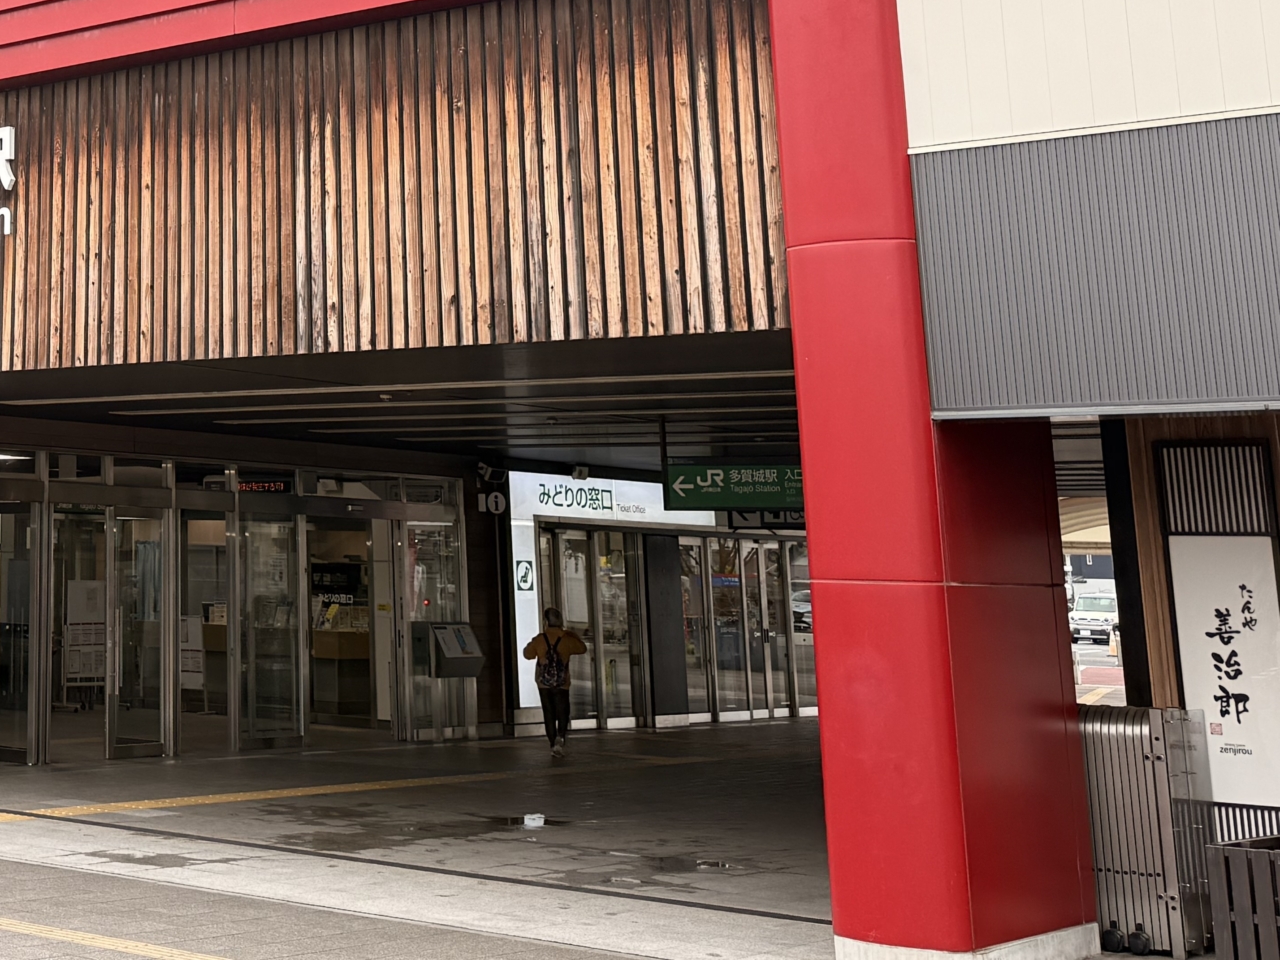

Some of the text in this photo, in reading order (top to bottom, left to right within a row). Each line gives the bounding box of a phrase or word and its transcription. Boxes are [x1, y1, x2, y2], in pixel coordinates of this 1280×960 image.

[696, 469, 725, 486] JR
[729, 469, 778, 483] 多賀城駅
[755, 483, 781, 492] Station
[538, 483, 613, 512] みどりの窓口
[1219, 746, 1253, 756] zenjirou
